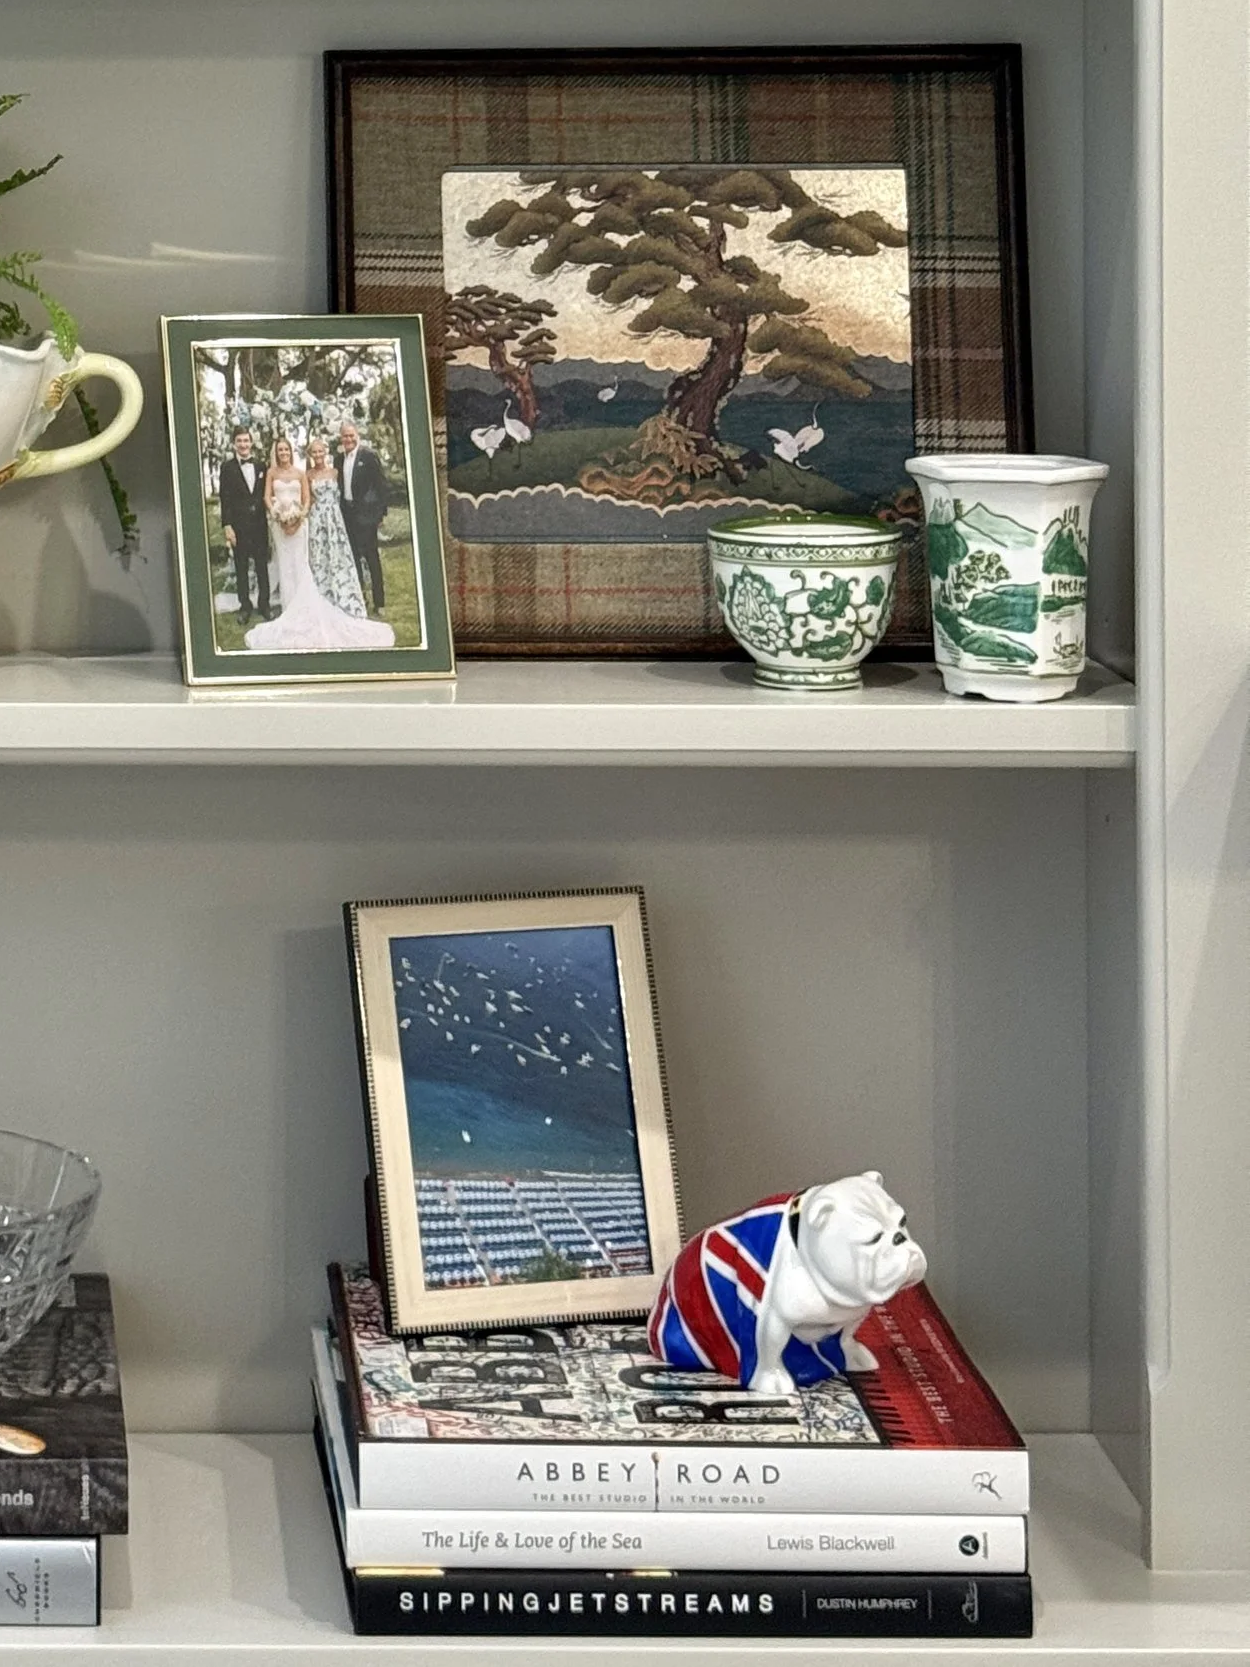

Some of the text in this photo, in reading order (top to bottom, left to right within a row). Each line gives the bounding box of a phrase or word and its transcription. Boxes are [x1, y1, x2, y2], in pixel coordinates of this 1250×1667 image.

[517, 1462, 781, 1485] ABBEY ROAD
[533, 1493, 766, 1505] THE BEST STUDIO IN THE WORLD
[421, 1530, 643, 1554] The Life & Love of the Sea
[766, 1535, 896, 1552] Lewis Blackwell
[815, 1597, 857, 1611] DUSTIN
[857, 1597, 919, 1611] HUMPHREY
